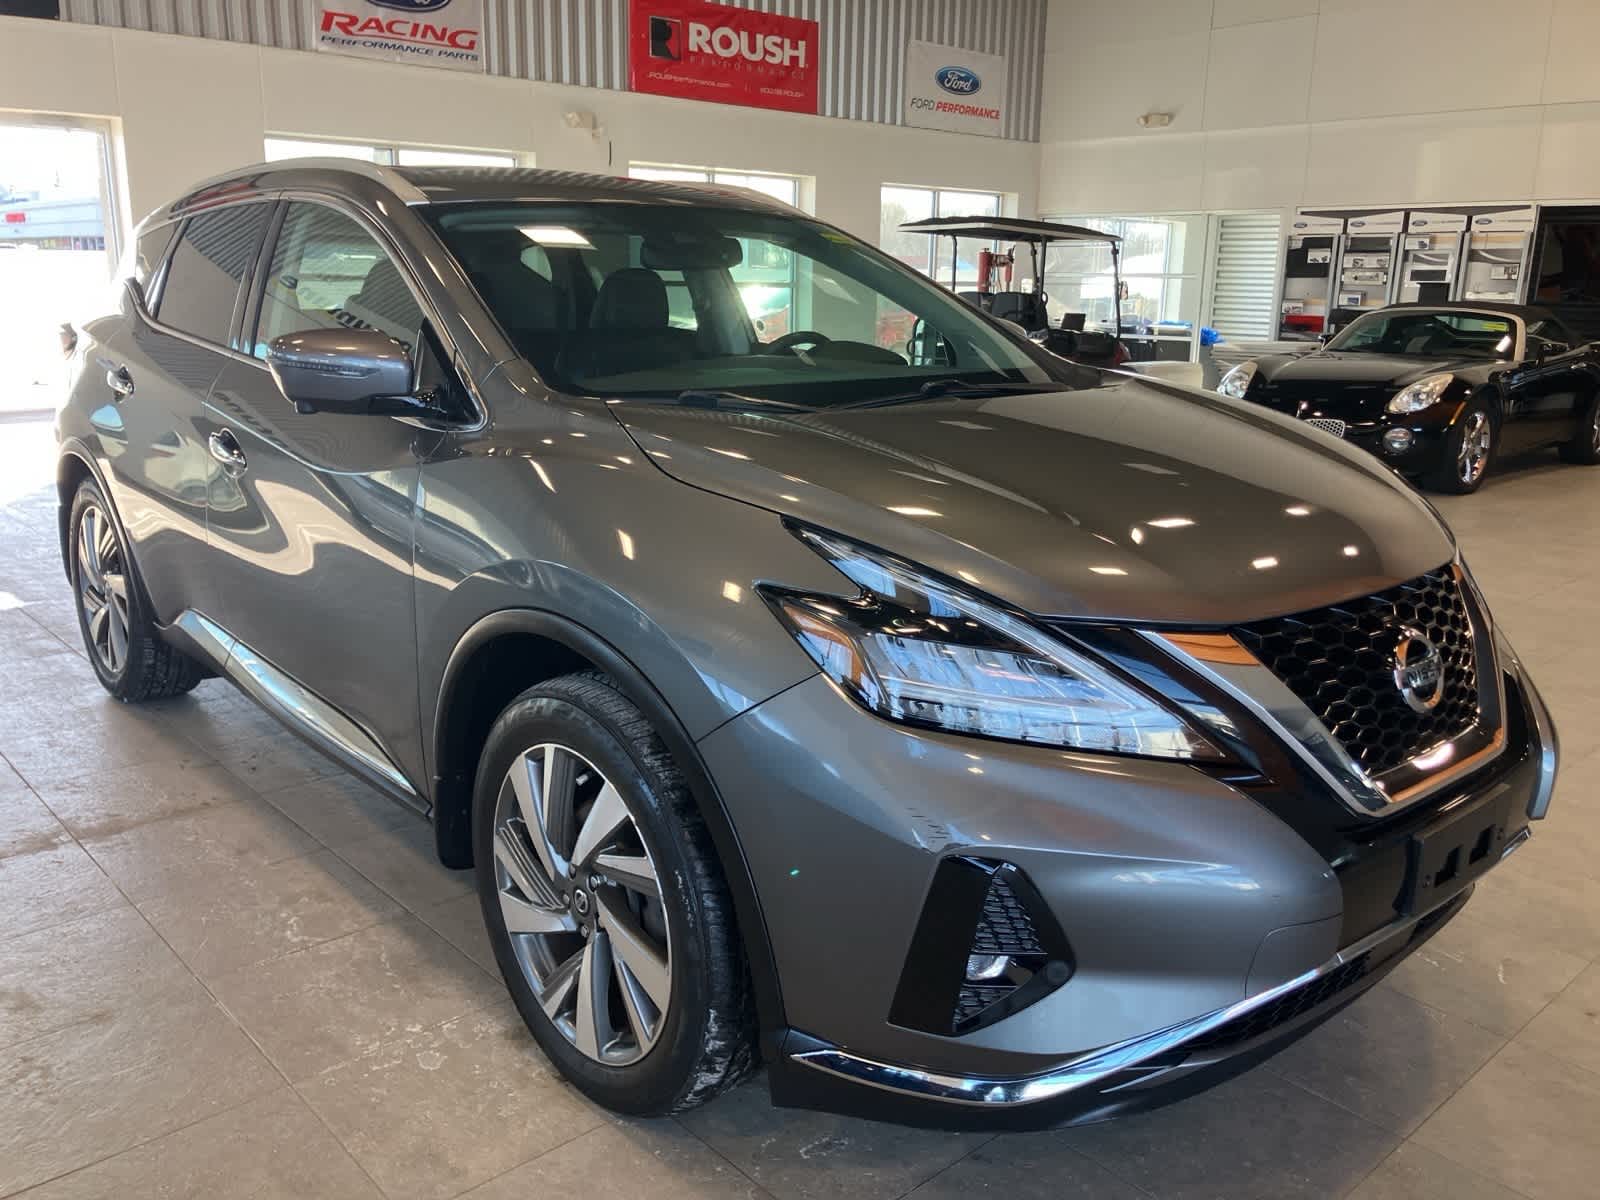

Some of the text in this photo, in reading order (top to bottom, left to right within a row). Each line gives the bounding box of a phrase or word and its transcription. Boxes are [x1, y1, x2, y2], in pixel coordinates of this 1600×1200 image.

[320, 9, 479, 50] RACING
[320, 34, 479, 62] PERFORMANCE PARTS
[688, 22, 807, 68] ROUSH
[944, 70, 973, 92] Ford
[910, 97, 1000, 120] FORD PERFORMANCE
